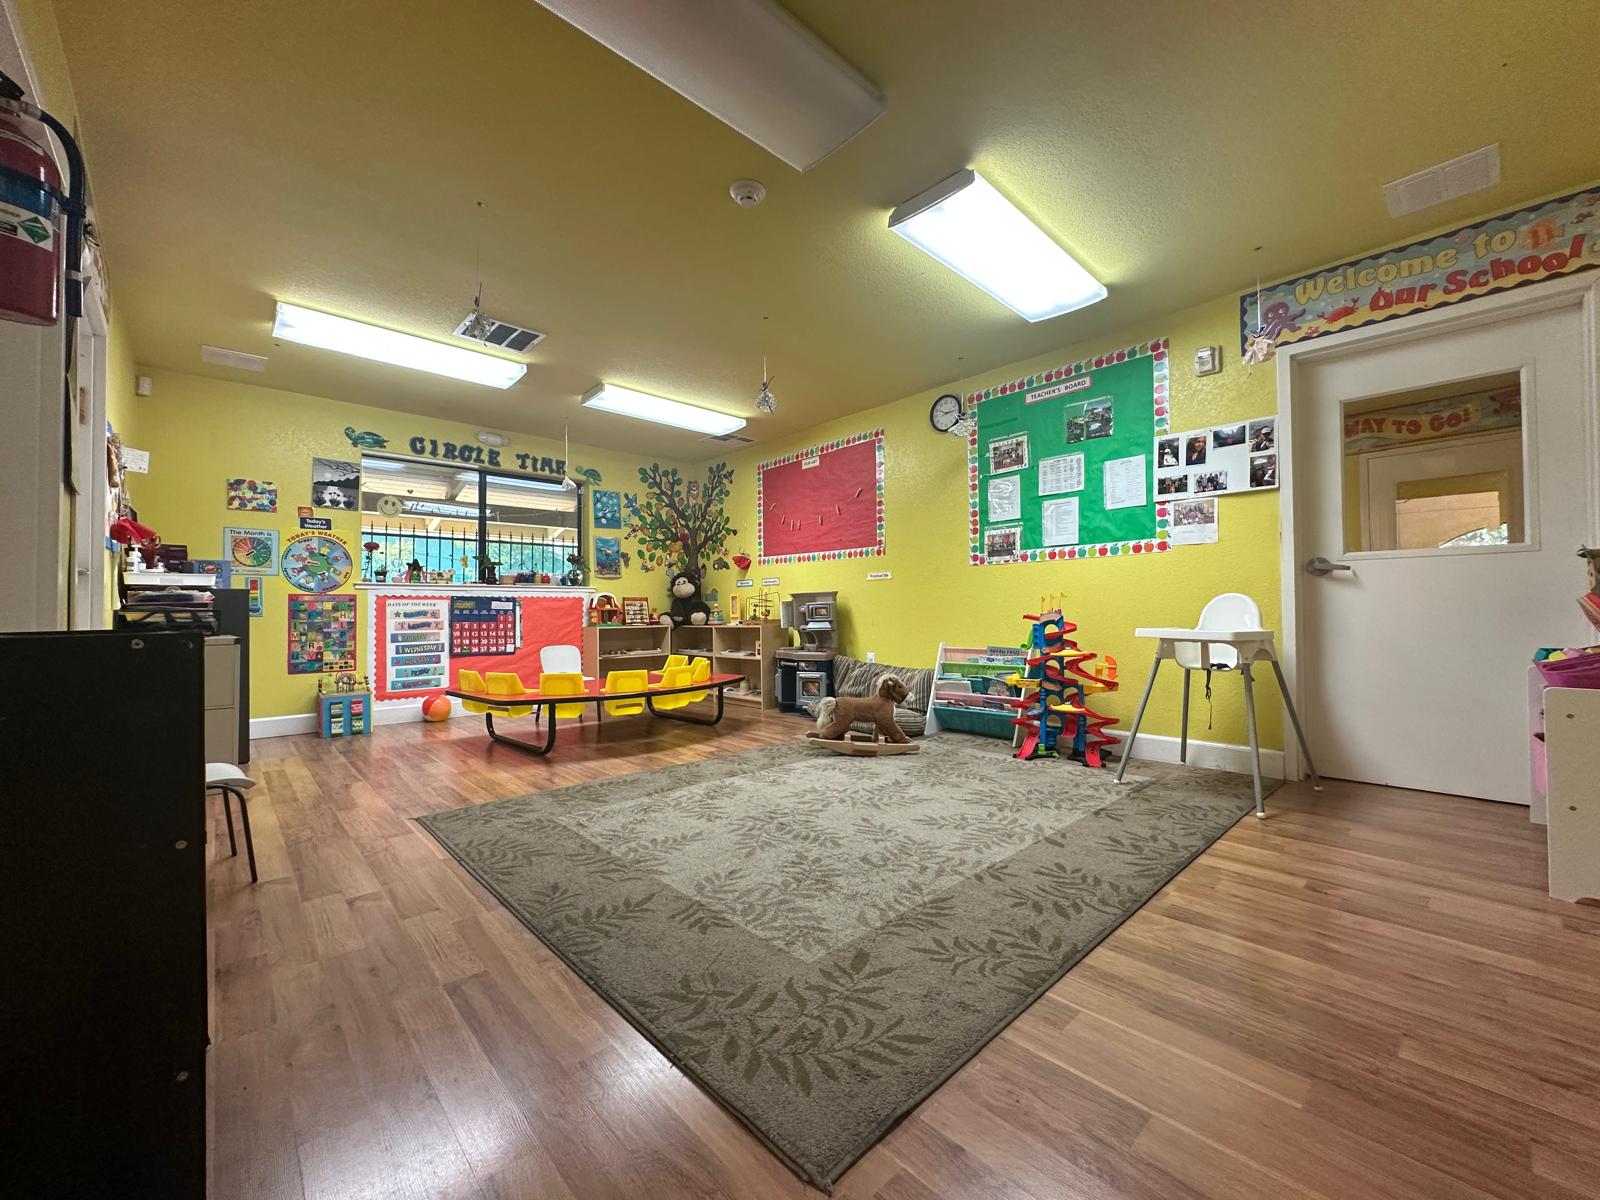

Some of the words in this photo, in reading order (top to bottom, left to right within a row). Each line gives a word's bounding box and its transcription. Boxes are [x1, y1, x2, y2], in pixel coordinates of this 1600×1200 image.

[1295, 248, 1458, 305] Welcome
[1473, 228, 1516, 259] to
[1369, 283, 1437, 311] Our
[1443, 234, 1585, 295] School
[1031, 387, 1061, 400] TEACHER'S
[1064, 380, 1086, 391] BOARD
[1344, 417, 1387, 438] WAY
[1392, 419, 1422, 434] TO
[1429, 408, 1471, 432] GO!
[409, 436, 501, 467] CIRCLE
[515, 453, 567, 475] TIME
[287, 530, 316, 543] TODAY'S
[318, 530, 348, 546] WEATHER
[404, 644, 437, 654] WEDNESDAY
